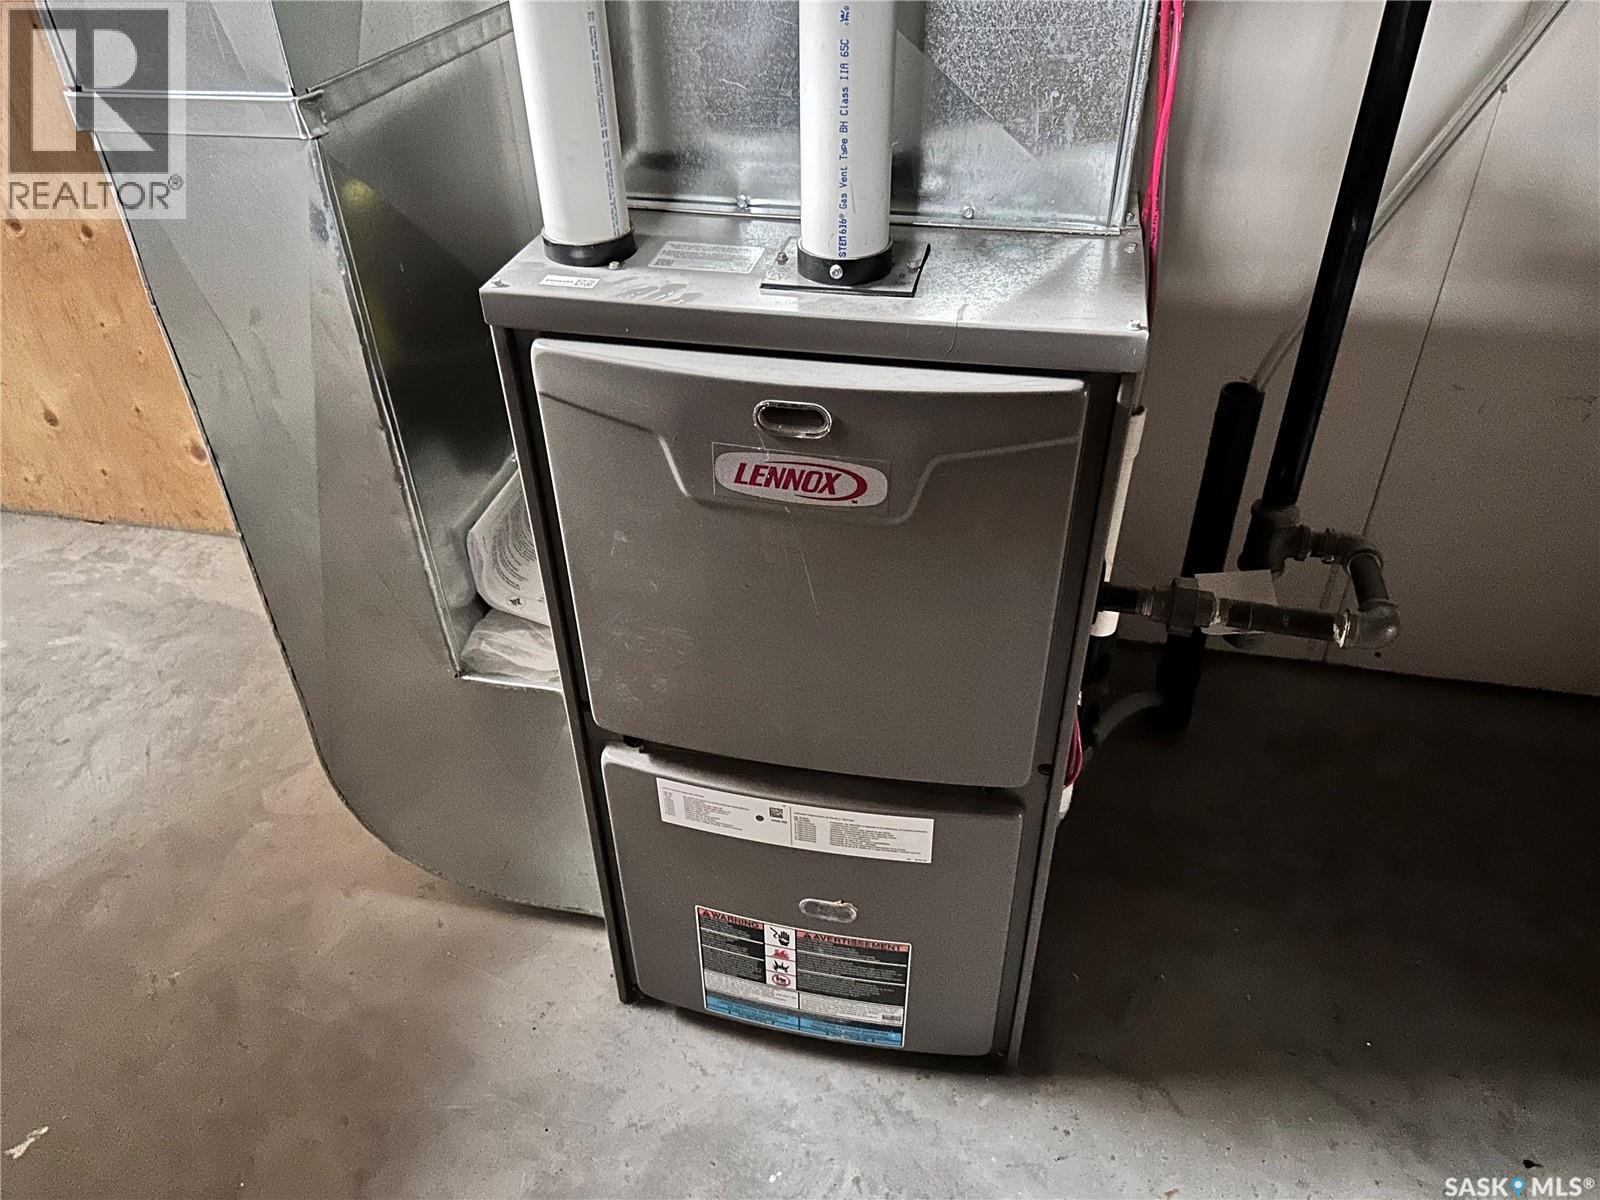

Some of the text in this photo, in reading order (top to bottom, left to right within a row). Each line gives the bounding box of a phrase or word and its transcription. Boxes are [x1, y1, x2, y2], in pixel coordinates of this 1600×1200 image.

[840, 39, 850, 57] 65C
[840, 86, 849, 116] Class
[839, 121, 848, 133] BH
[839, 138, 849, 160] Type
[839, 166, 848, 189] Vent
[839, 193, 848, 210] Gas
[733, 462, 842, 496] LENNOX
[711, 910, 760, 929] WARNING
[813, 933, 901, 952] AVERTISSEMENT
